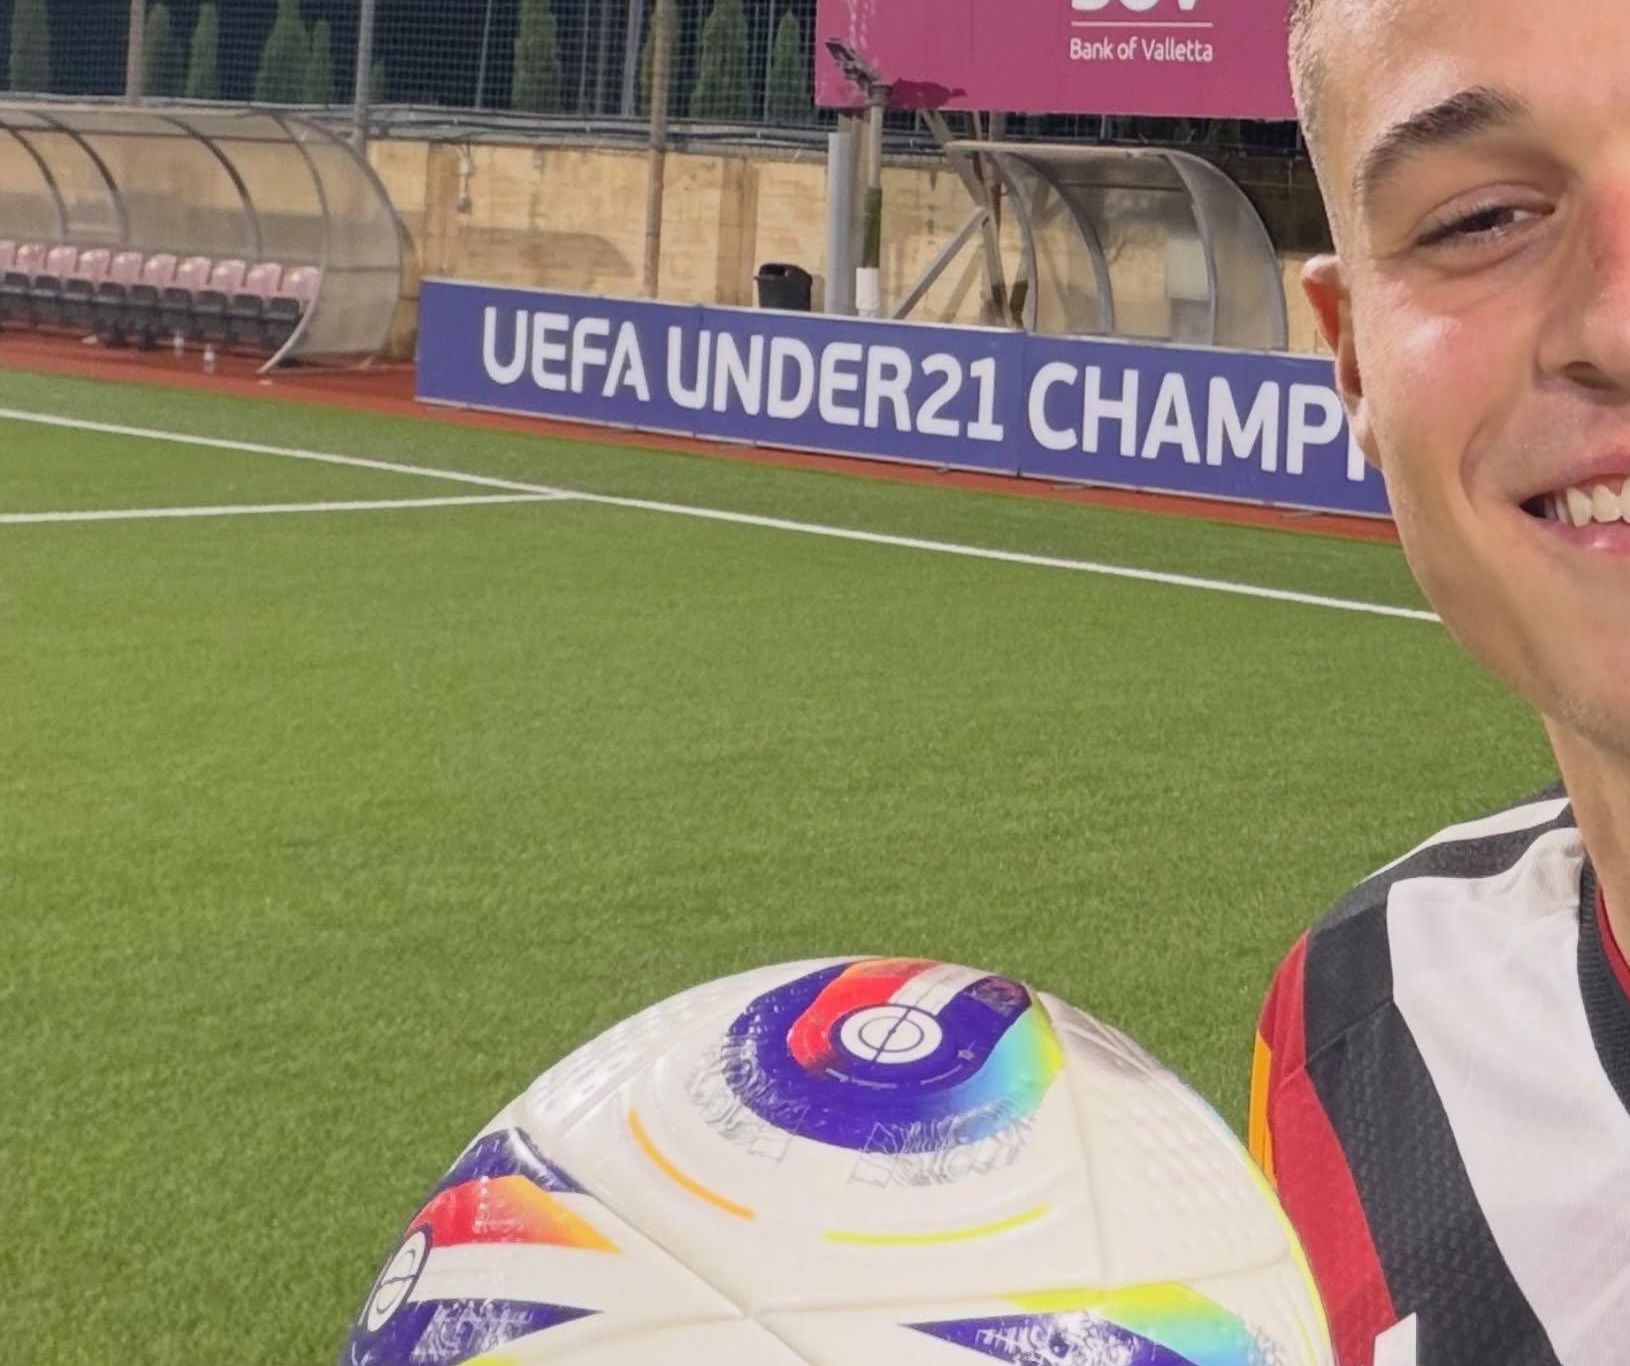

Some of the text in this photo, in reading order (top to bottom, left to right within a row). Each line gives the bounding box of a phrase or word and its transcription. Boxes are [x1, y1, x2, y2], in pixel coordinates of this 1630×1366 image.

[1069, 36, 1214, 63] Bank of Valletta
[482, 306, 651, 402] UEFA
[666, 325, 1005, 442] UNDER21
